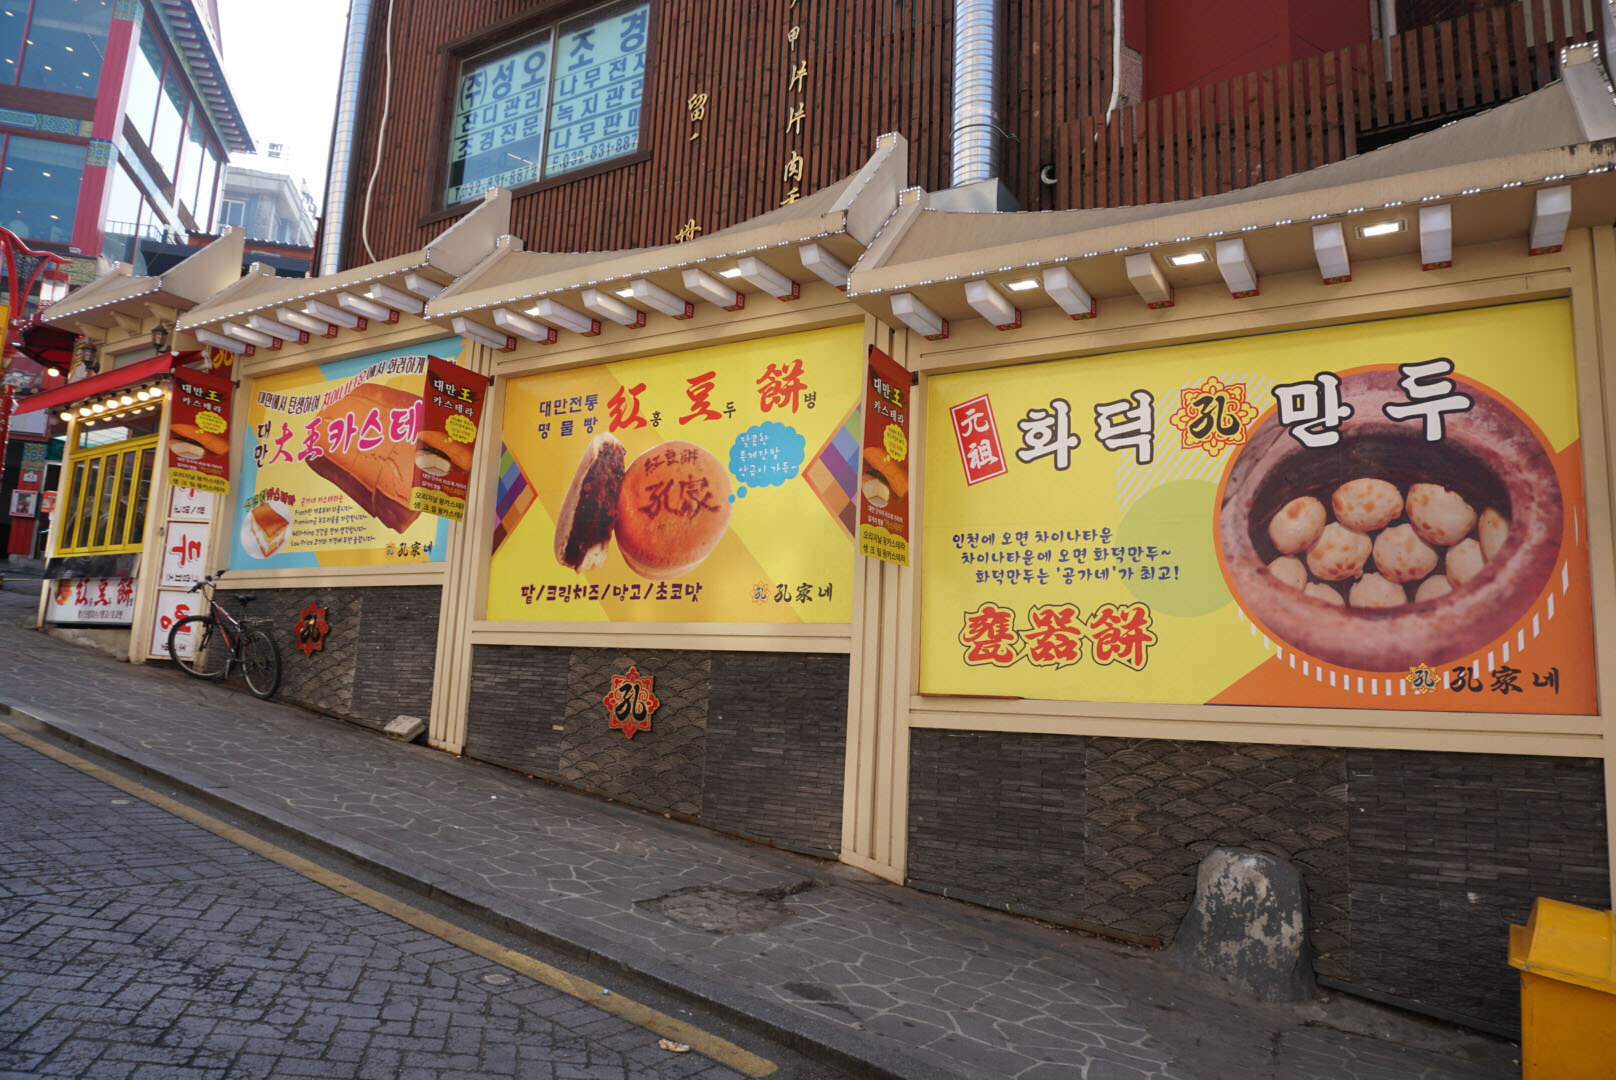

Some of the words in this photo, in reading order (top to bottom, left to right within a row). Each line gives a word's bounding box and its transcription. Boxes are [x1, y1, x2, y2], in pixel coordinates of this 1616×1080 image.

[432, 396, 474, 418] 카스테라
[539, 393, 599, 417] 대만전통
[873, 400, 905, 426] 카스테라
[1014, 388, 1155, 471] 화덕
[1271, 356, 1475, 449] 만두
[952, 531, 996, 549] 인천에
[1000, 530, 1029, 547] 오면
[1034, 526, 1113, 545] 차이나타운
[960, 549, 1052, 566] 차이나타운에
[1058, 547, 1087, 564] 오면
[975, 567, 1051, 585] 화덕만두는
[1139, 565, 1180, 581] 최고!
